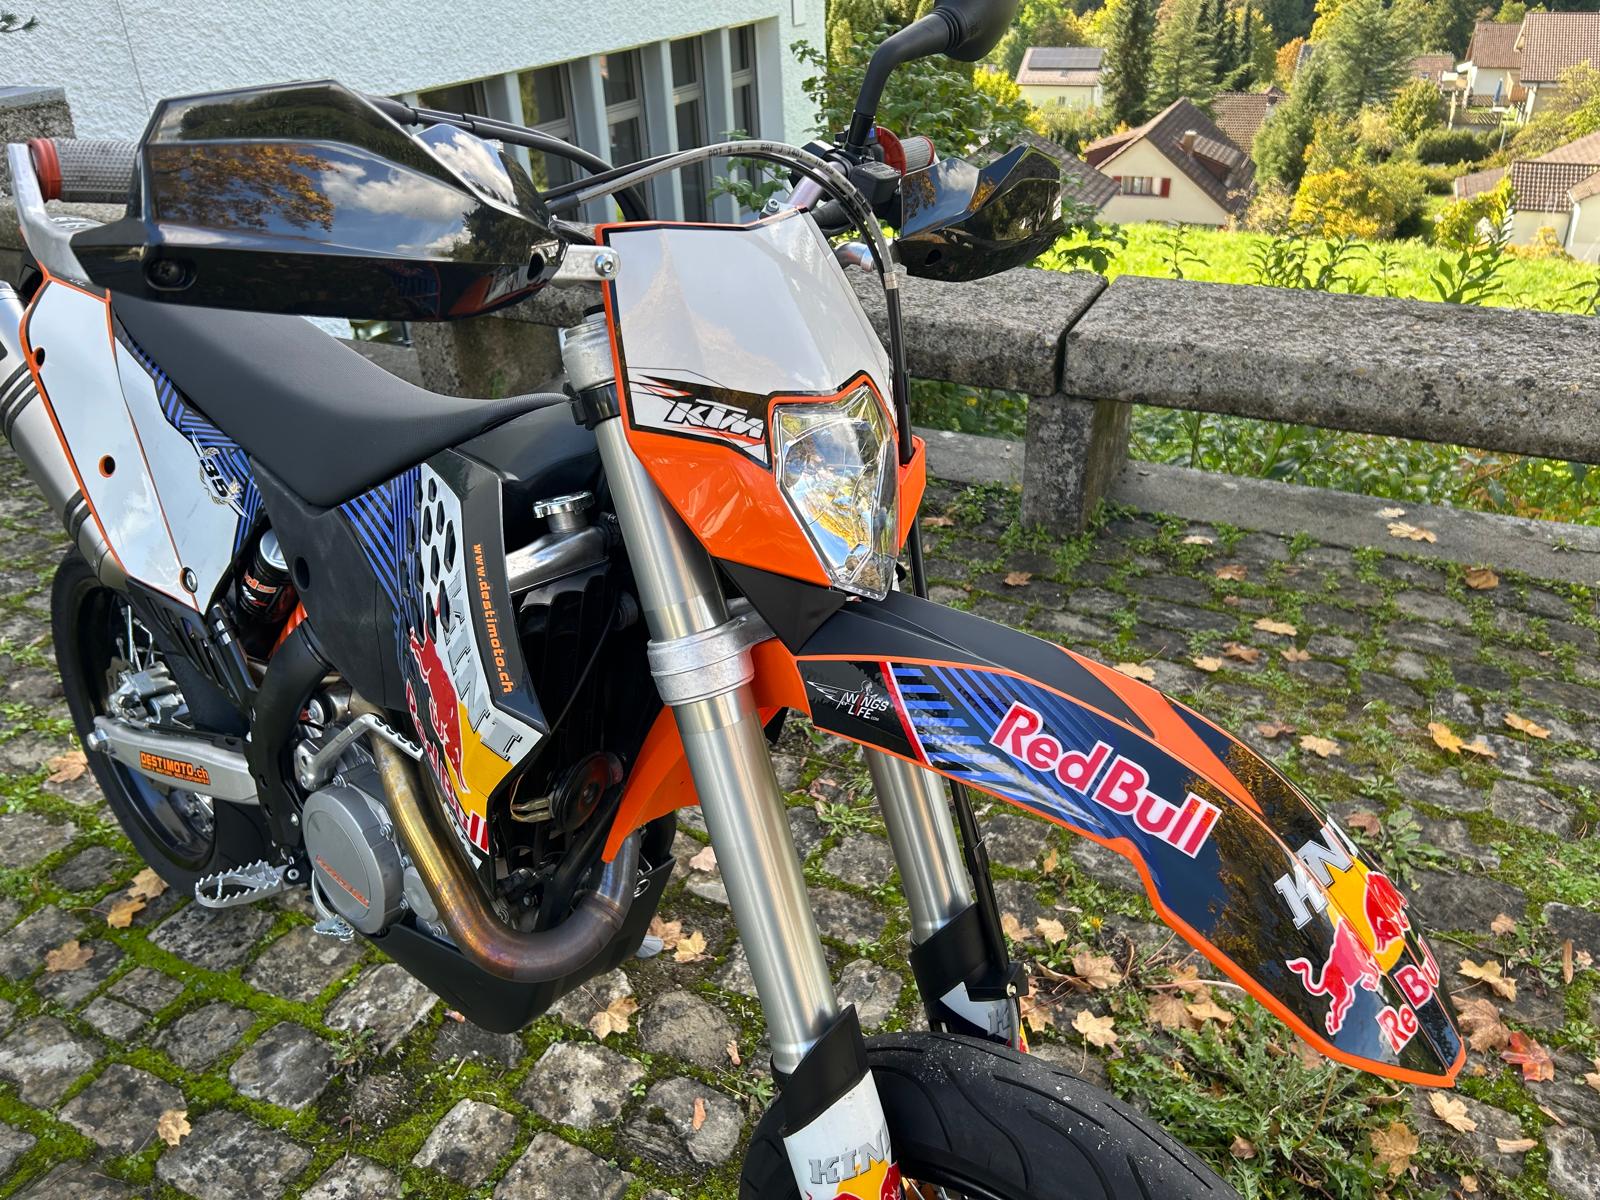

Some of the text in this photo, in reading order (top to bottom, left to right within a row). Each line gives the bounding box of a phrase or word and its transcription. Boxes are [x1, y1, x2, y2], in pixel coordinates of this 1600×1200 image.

[663, 398, 764, 440] KTM
[199, 457, 229, 498] 35
[472, 543, 515, 693] www.destimoto.ch
[843, 691, 890, 711] WINGS
[140, 751, 209, 779] DESTIMOTO.ch
[989, 700, 1222, 859] Red Bull
